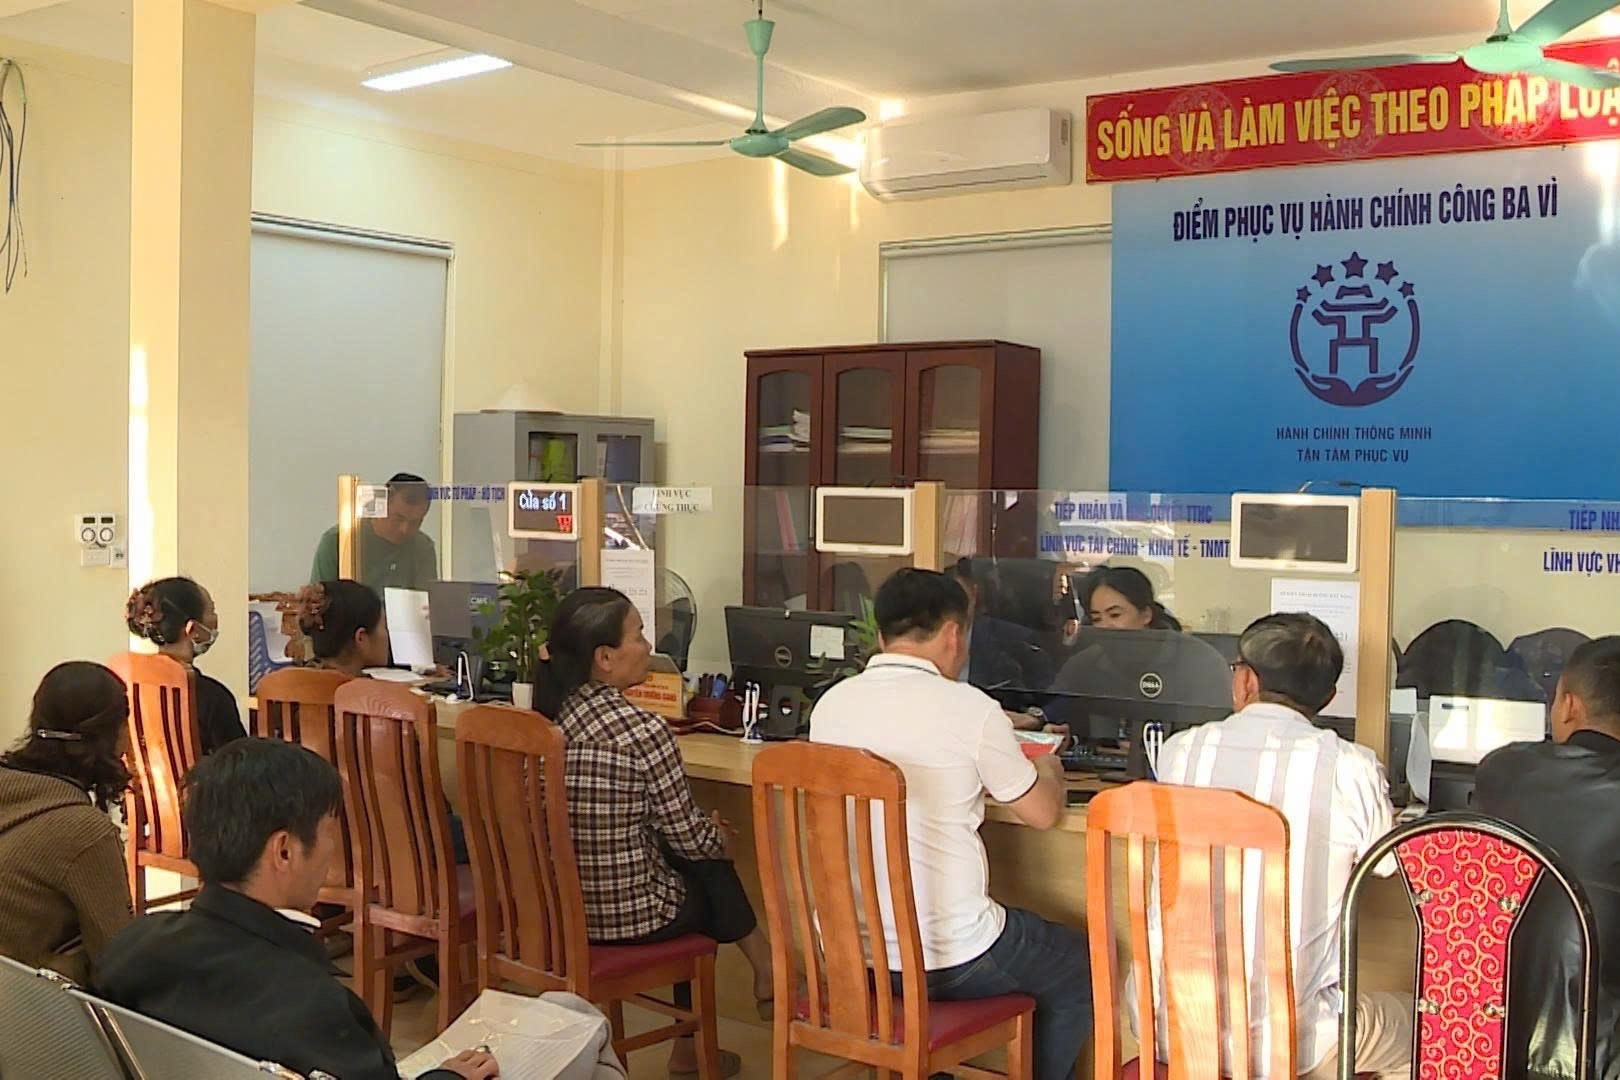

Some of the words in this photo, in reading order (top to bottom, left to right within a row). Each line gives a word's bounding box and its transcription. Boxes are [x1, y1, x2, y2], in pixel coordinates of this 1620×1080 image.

[1097, 103, 1171, 161] SỐNG
[1178, 103, 1215, 153] VÀ
[1224, 97, 1285, 149] LÀM
[1294, 87, 1361, 149] VIỆC
[1371, 85, 1449, 136] THEO
[1173, 197, 1219, 242] ĐIỂM
[1225, 204, 1274, 243] PHỤC
[1280, 202, 1304, 240] VỤ
[1310, 193, 1363, 232] HÀNH
[1370, 187, 1431, 228] CHÍNH
[1439, 183, 1495, 224] CÔNG
[1502, 185, 1531, 220] BA
[1538, 176, 1557, 218] VÌ
[1355, 425, 1395, 440] THÔNG
[1400, 426, 1432, 440] MINH
[1326, 447, 1350, 462] TÂM
[1355, 449, 1388, 463] PHỤC
[1393, 449, 1409, 463] VỤ
[559, 493, 566, 511] 1
[1078, 499, 1107, 523] NHẬN
[1148, 538, 1174, 556] KINH
[1177, 533, 1190, 558] TẾ
[1200, 539, 1230, 558] TNMT
[1543, 547, 1572, 572] LĨNH
[1578, 550, 1603, 577] VỰC
